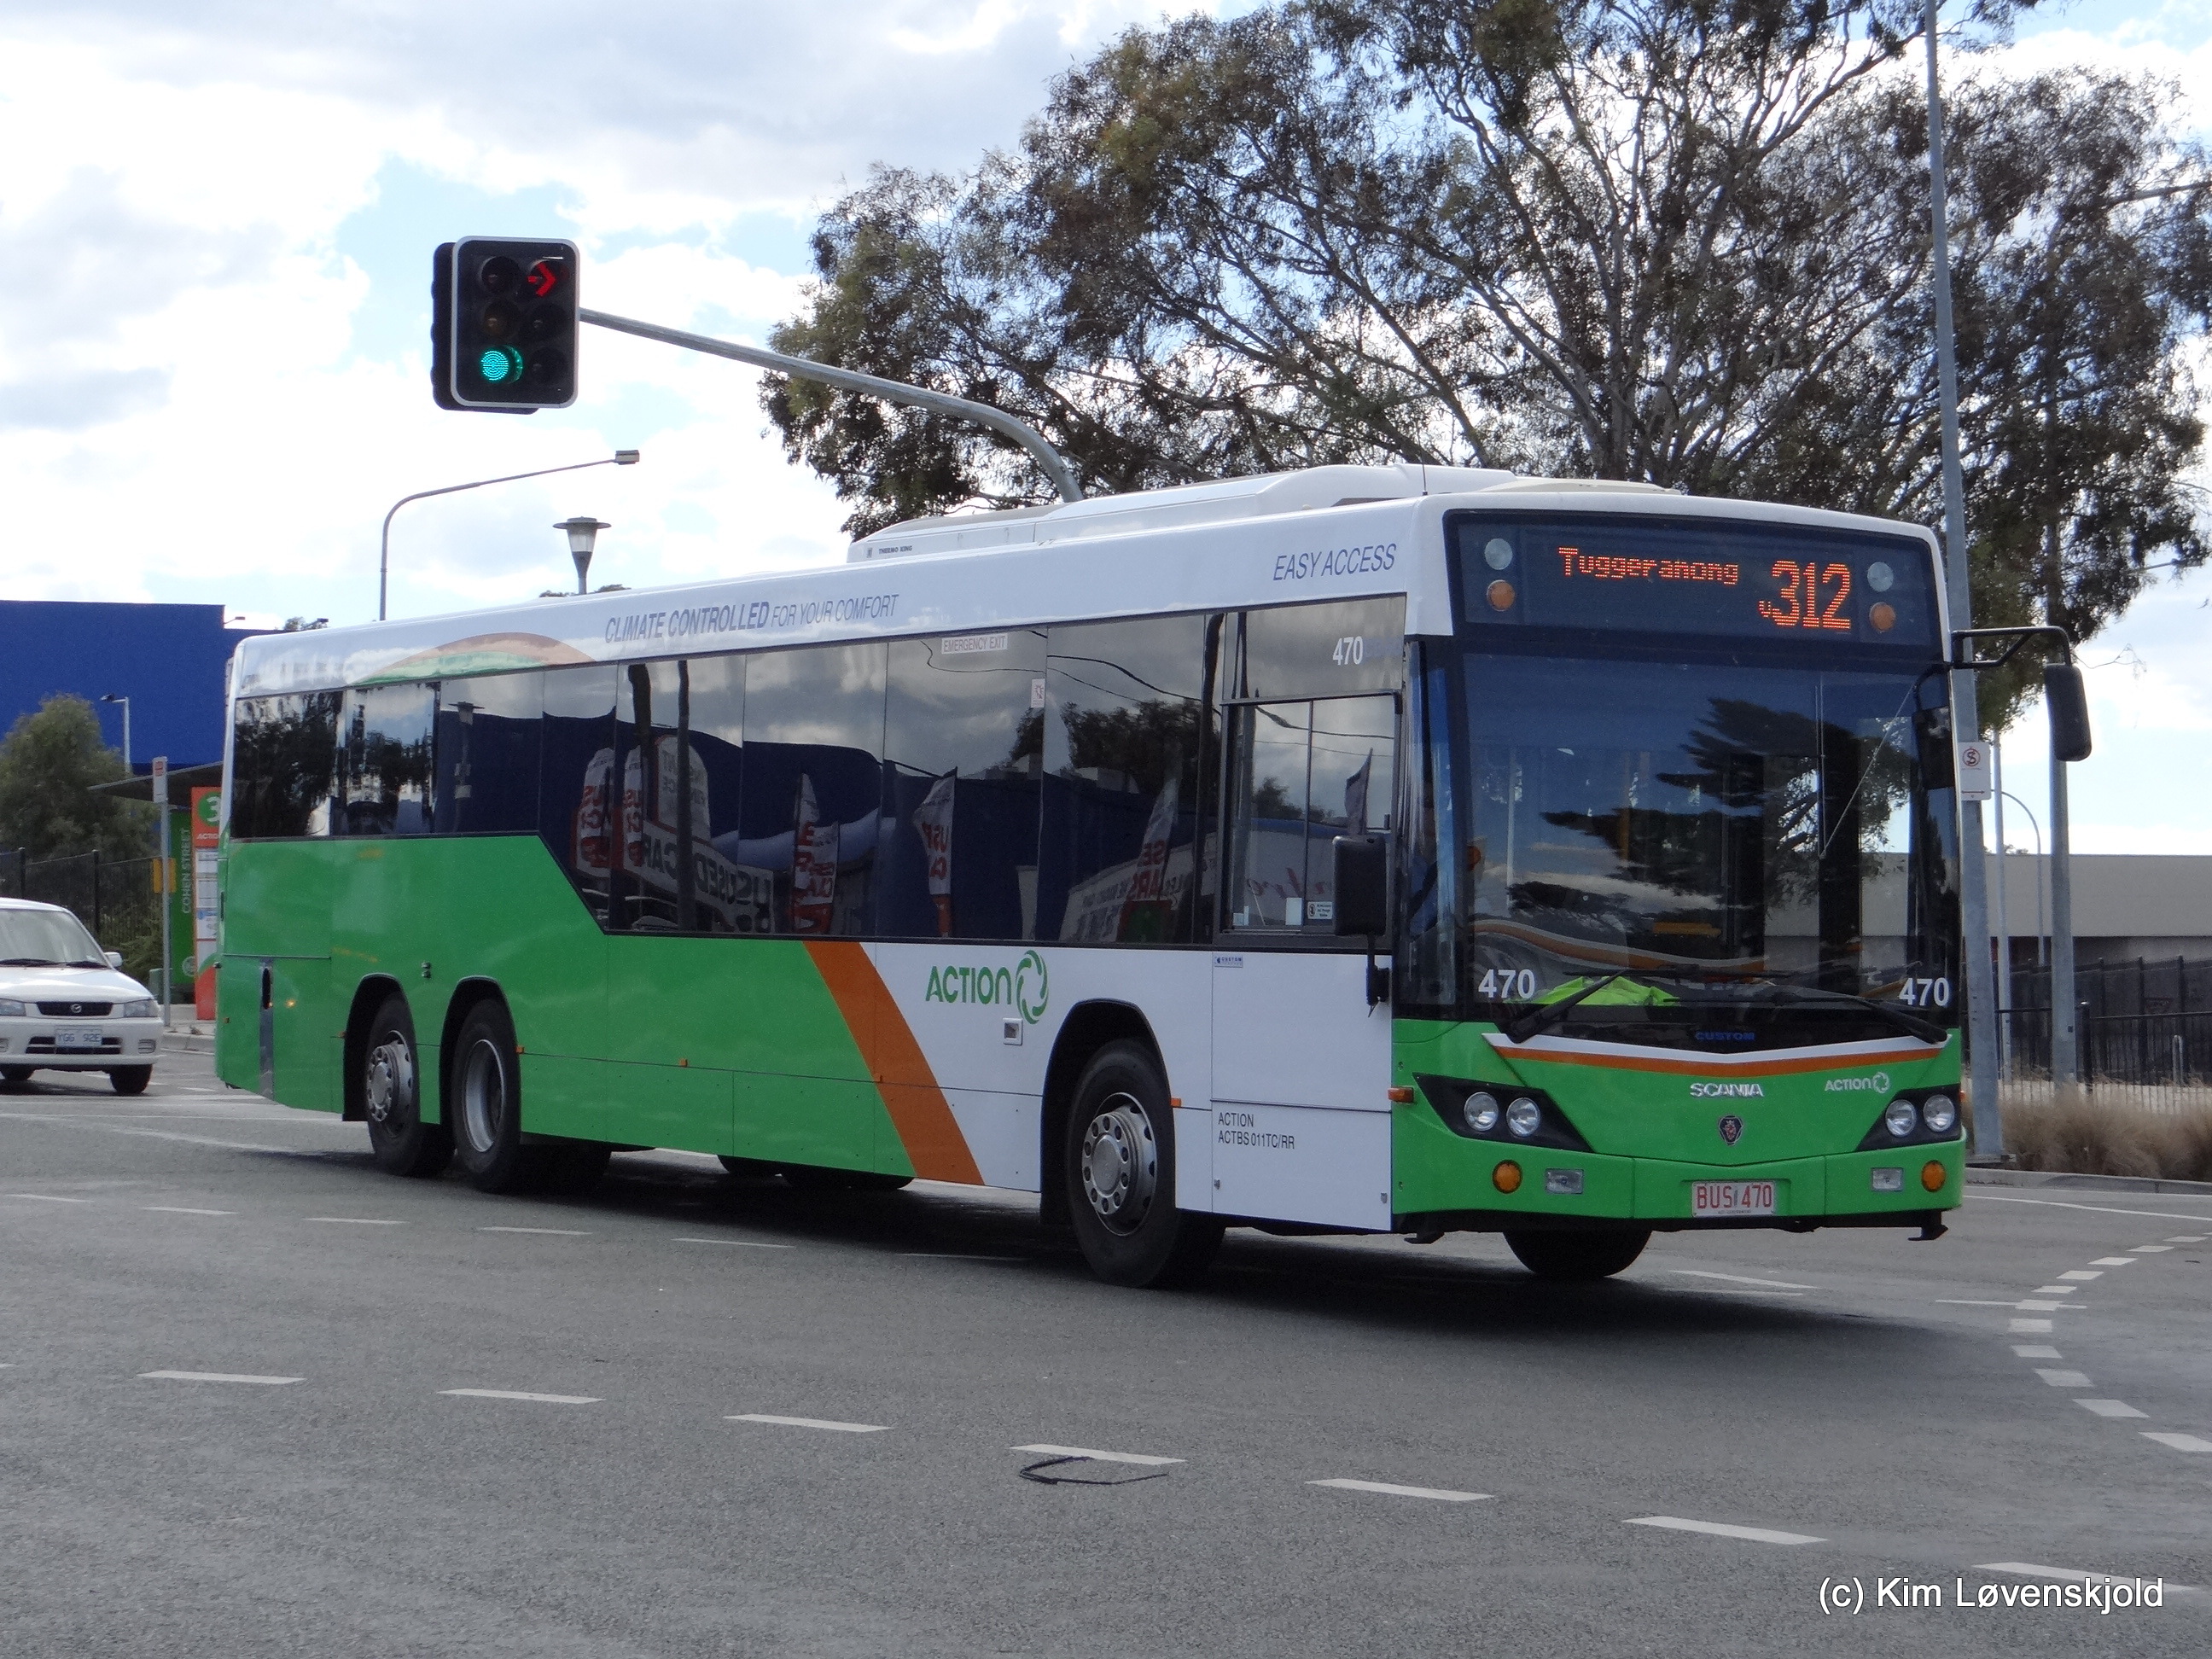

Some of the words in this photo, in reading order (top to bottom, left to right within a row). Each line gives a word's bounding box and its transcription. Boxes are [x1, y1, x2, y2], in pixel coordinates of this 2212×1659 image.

[1273, 551, 1322, 581] EASY
[1321, 543, 1397, 577] ACCESS
[1557, 545, 1739, 586] Tuggeranong
[1772, 560, 1851, 629] 312
[605, 611, 667, 643] CLIMATE
[668, 601, 769, 637] CONTROLLED
[770, 605, 796, 627] FOR
[800, 600, 834, 625] YOUR
[835, 594, 899, 622] COMFORT
[943, 637, 988, 653] EMERGENCY
[989, 635, 1006, 649] EXIT
[1332, 636, 1364, 666] 470
[206, 795, 222, 823] 3
[180, 828, 191, 870] STREET
[182, 873, 192, 914] COHEN
[925, 966, 1012, 1005] ACTION
[1477, 969, 1535, 1000] 470
[1899, 977, 1950, 1008] 470
[1695, 1031, 1755, 1041] CUSTOM
[1690, 1082, 1765, 1097] SCANIA
[1824, 1077, 1872, 1091] ACTION
[1218, 1112, 1254, 1127] ACTION
[1218, 1130, 1249, 1146] ACTBS
[1250, 1132, 1295, 1150] 011TC/RR
[1697, 1185, 1732, 1209] BUS
[1741, 1185, 1773, 1208] 470
